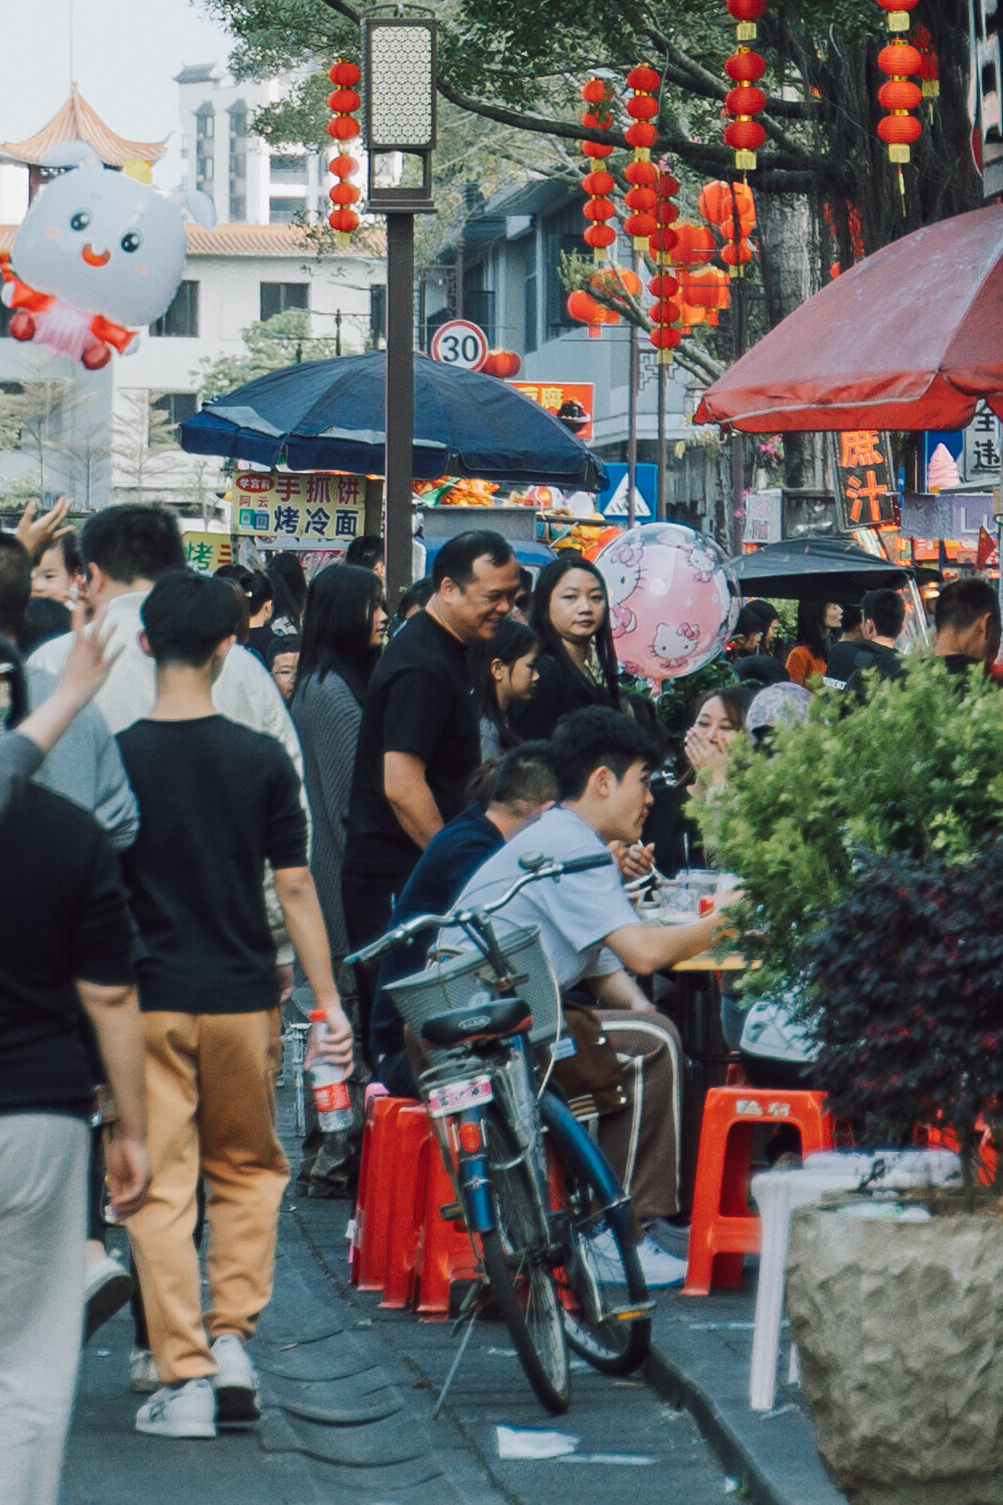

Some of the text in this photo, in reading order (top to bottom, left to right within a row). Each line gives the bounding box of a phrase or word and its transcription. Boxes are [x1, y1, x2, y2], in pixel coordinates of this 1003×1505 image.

[442, 335, 479, 362] 30
[239, 495, 269, 507] 阿云
[275, 475, 361, 505] 手抓饼
[274, 505, 360, 536] 烤冷面
